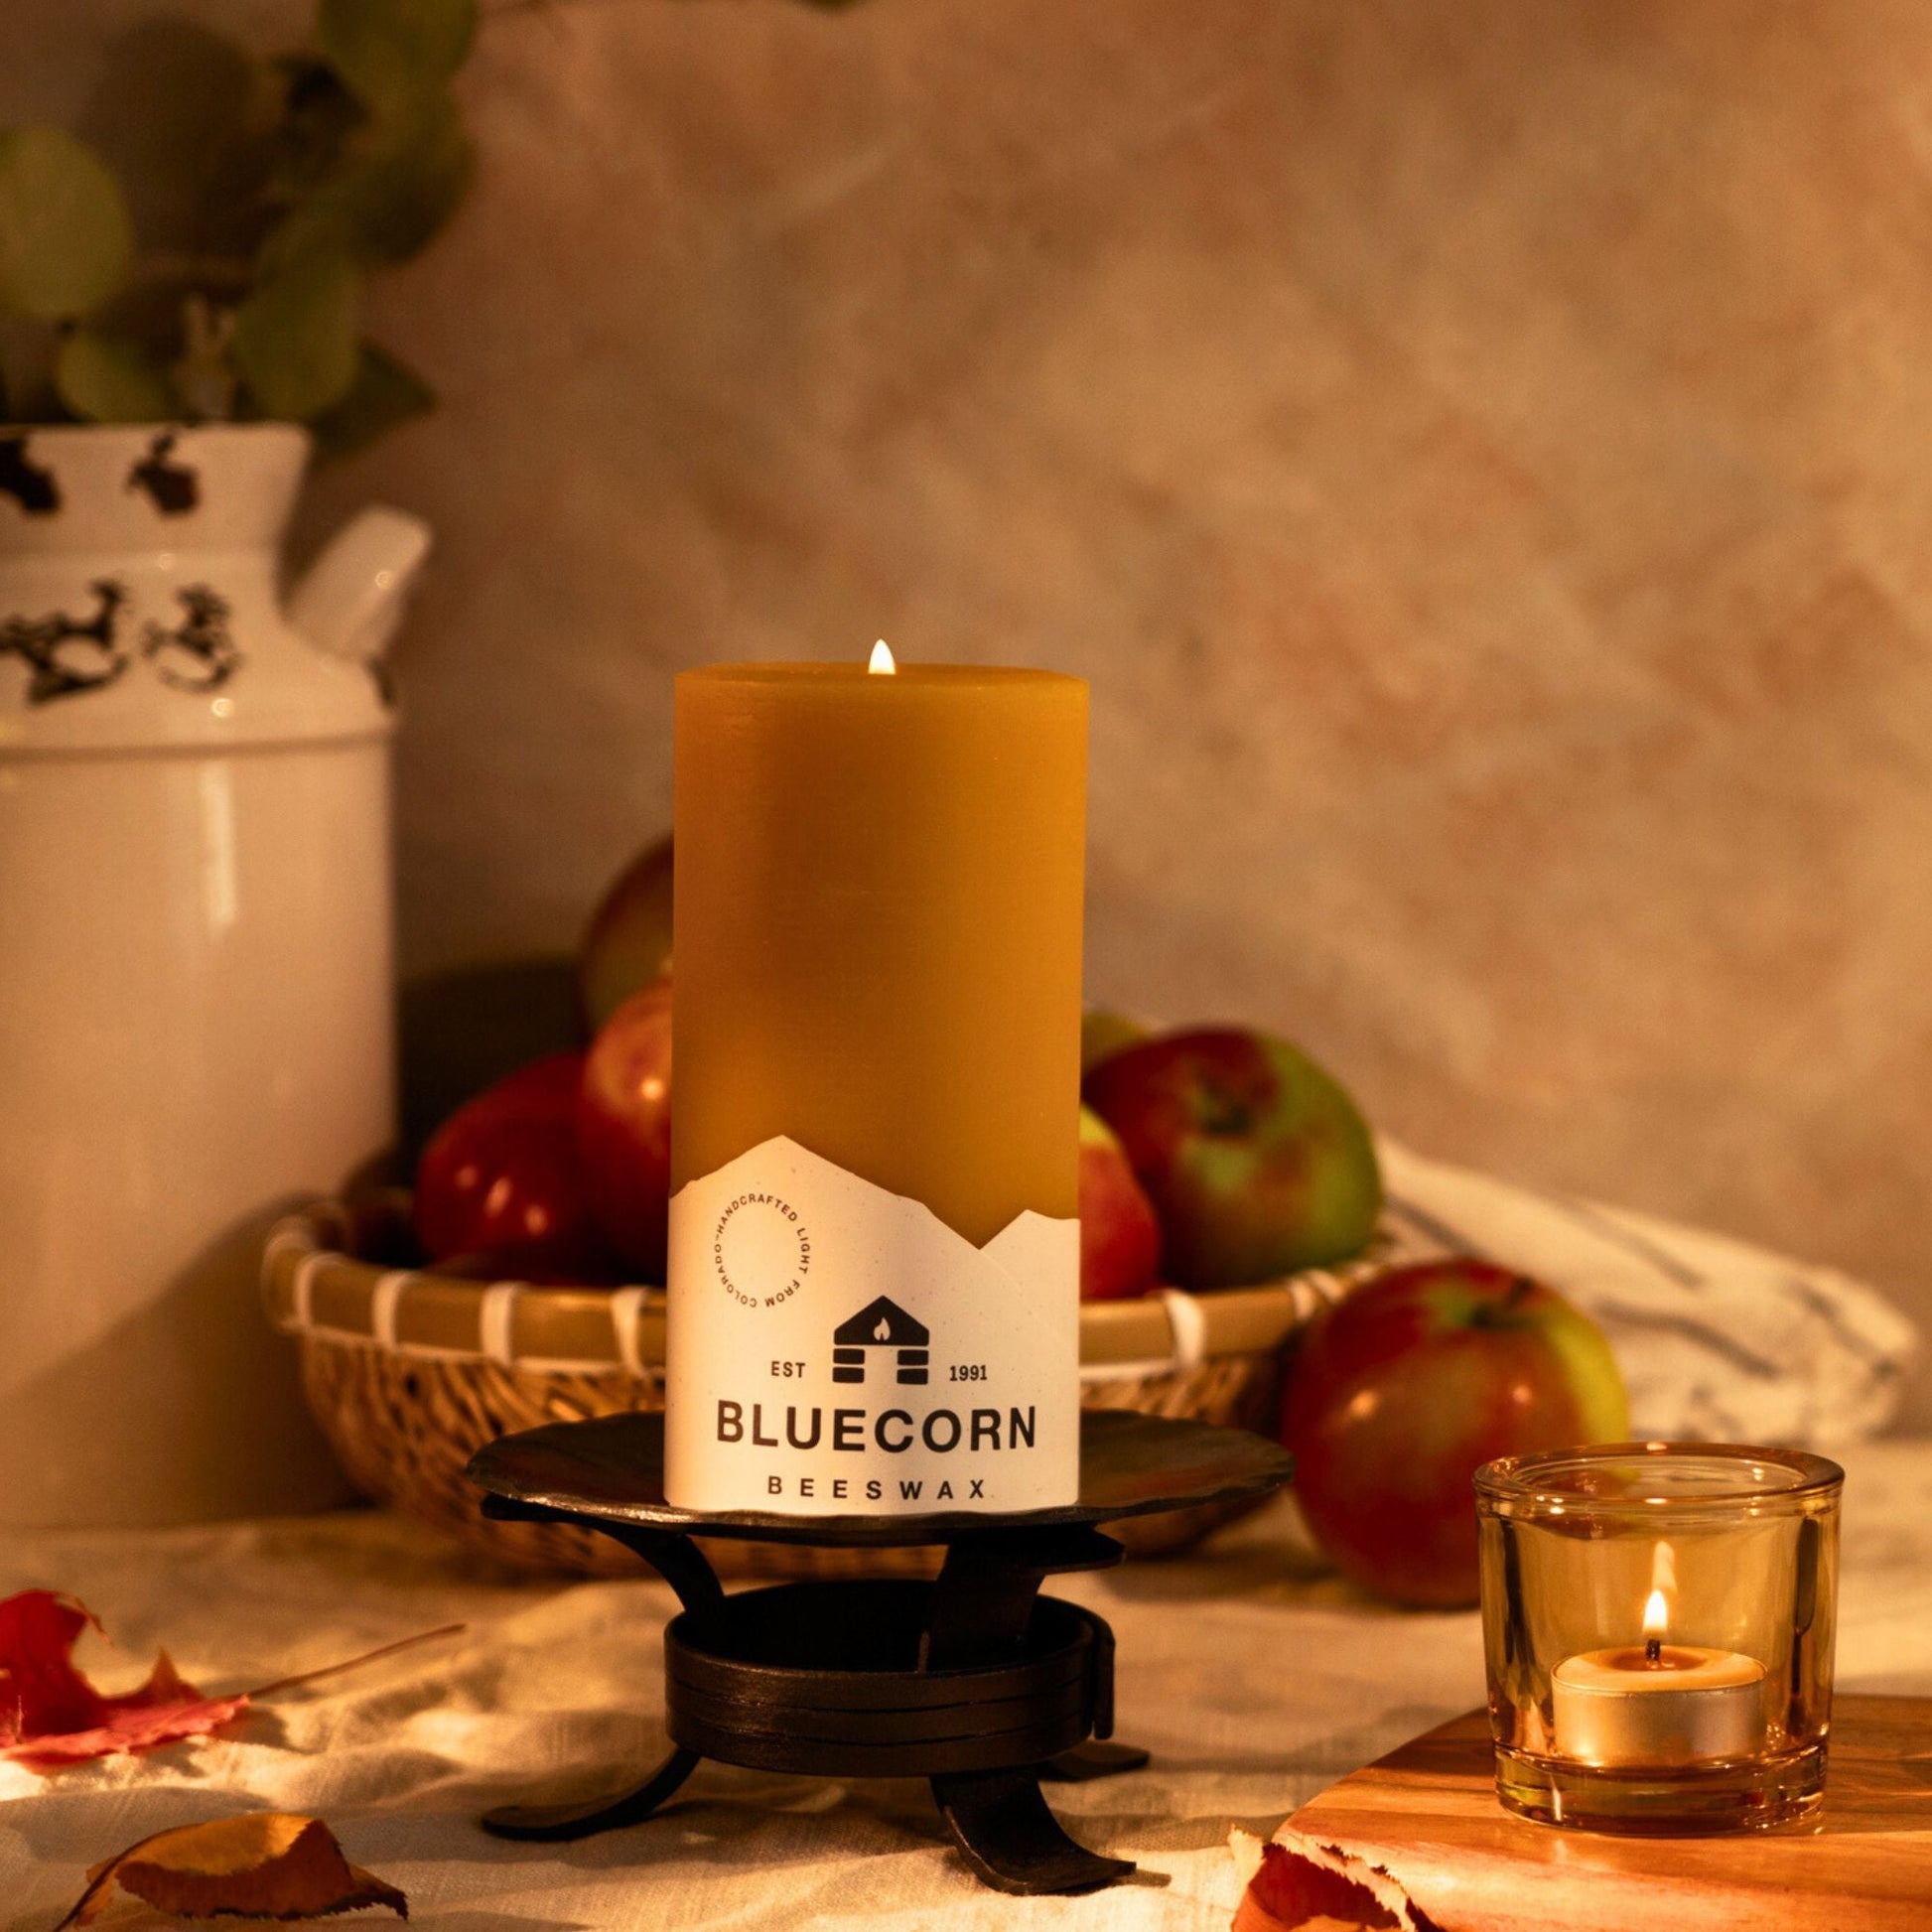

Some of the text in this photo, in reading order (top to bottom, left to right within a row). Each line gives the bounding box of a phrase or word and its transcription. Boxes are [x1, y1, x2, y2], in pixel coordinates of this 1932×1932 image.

[717, 1193, 798, 1234] HANDCRAFTED
[796, 1227, 810, 1275] LIGHT
[764, 1279, 800, 1308] FROM
[771, 1361, 988, 1381] EST 1991
[717, 1400, 1035, 1452] BLUECORN
[767, 1475, 984, 1500] BEESWAX
